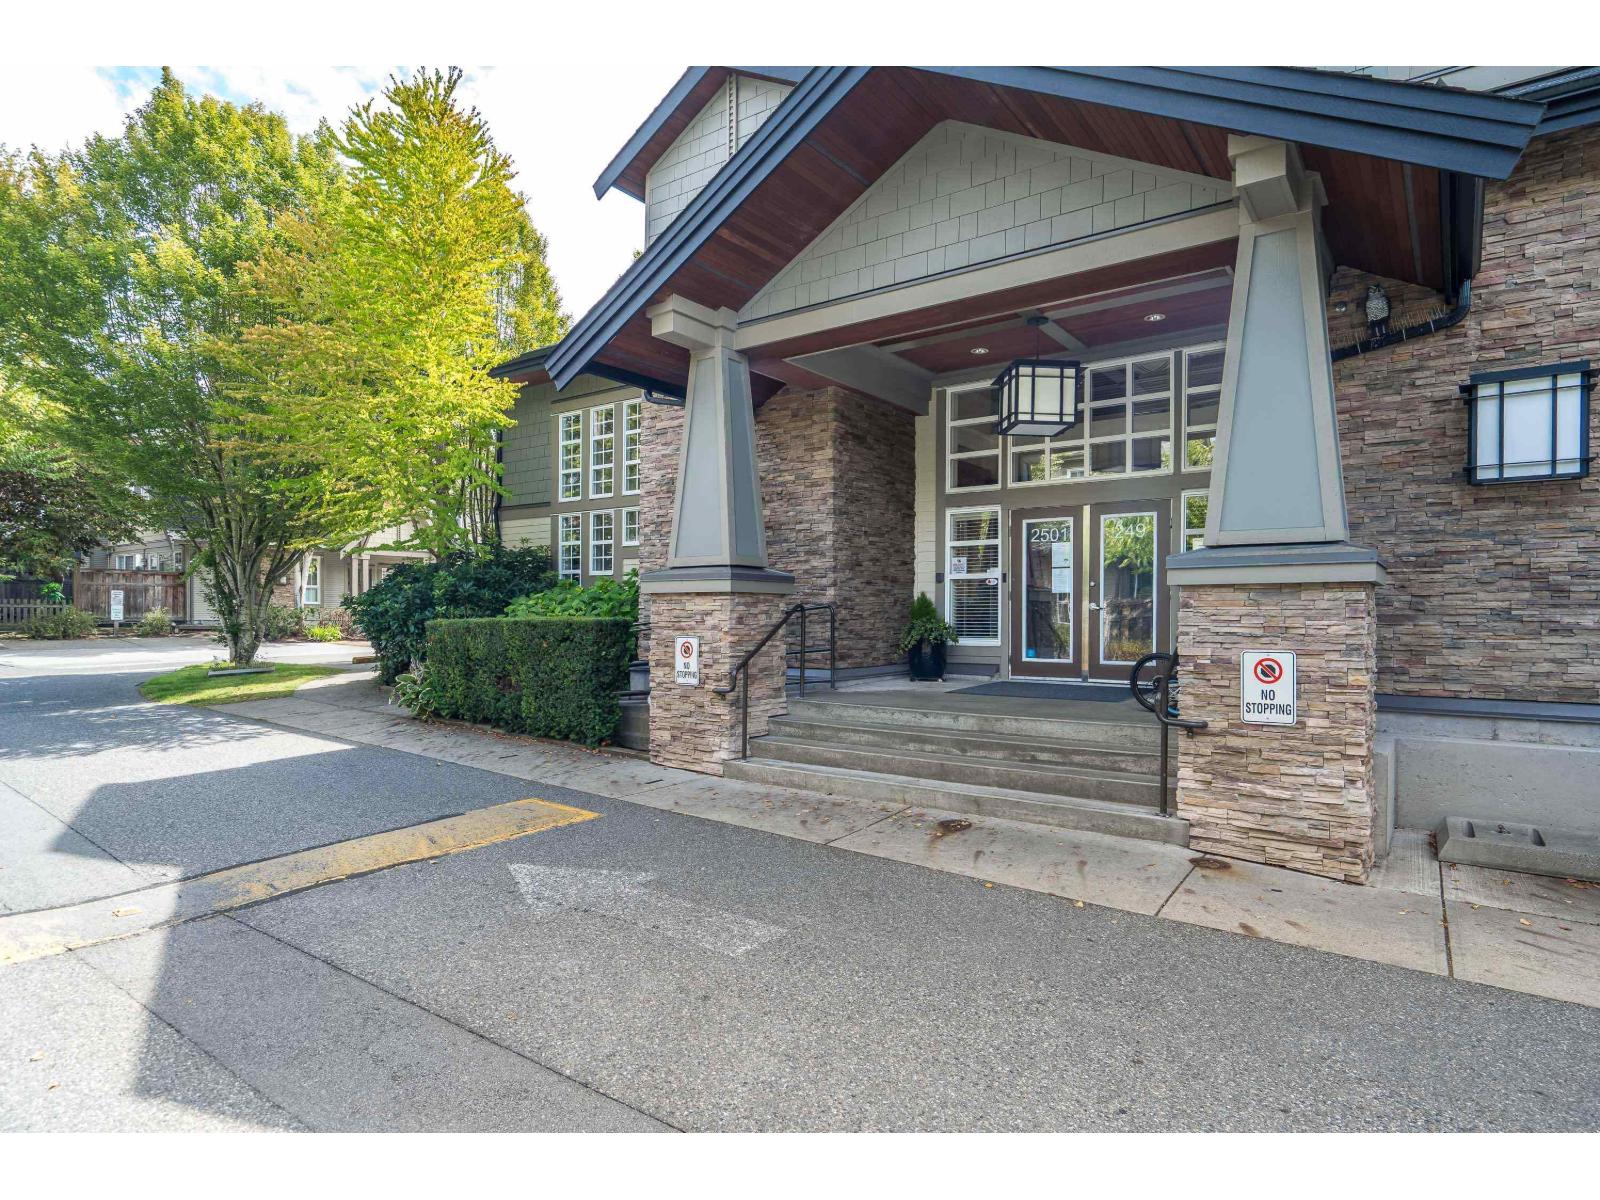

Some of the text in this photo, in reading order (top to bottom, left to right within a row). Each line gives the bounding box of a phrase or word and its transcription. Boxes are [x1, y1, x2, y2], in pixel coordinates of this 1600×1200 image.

[1031, 527, 1068, 542] 2501
[677, 671, 697, 679] STOPPING
[1261, 690, 1275, 700] NO
[1246, 703, 1291, 715] STOPPING
